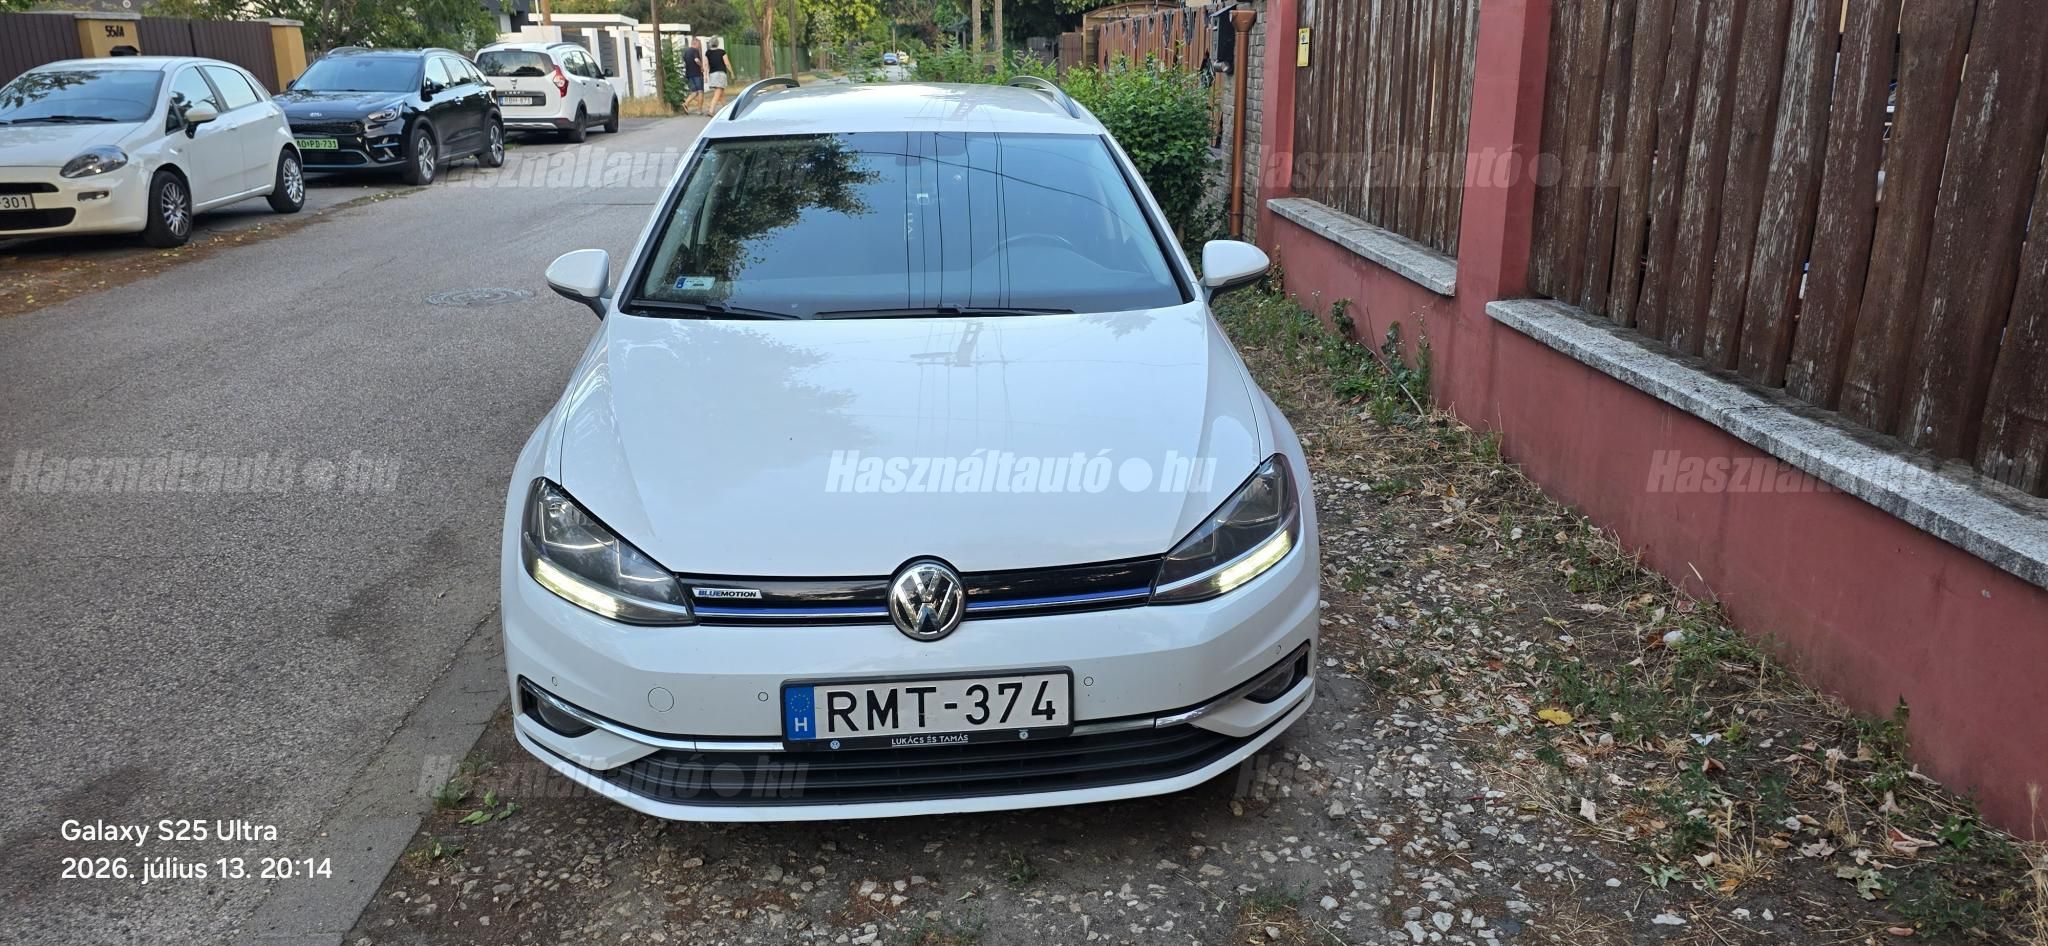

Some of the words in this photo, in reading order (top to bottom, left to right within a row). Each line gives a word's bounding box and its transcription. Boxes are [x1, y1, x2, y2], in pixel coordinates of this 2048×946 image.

[698, 590, 757, 598] BLUEMOTION
[827, 680, 1056, 733] RMT-374
[795, 717, 808, 732] H
[891, 737, 924, 746] LUKÁCS
[926, 734, 937, 744] ÉS
[940, 733, 969, 743] TAMÁS
